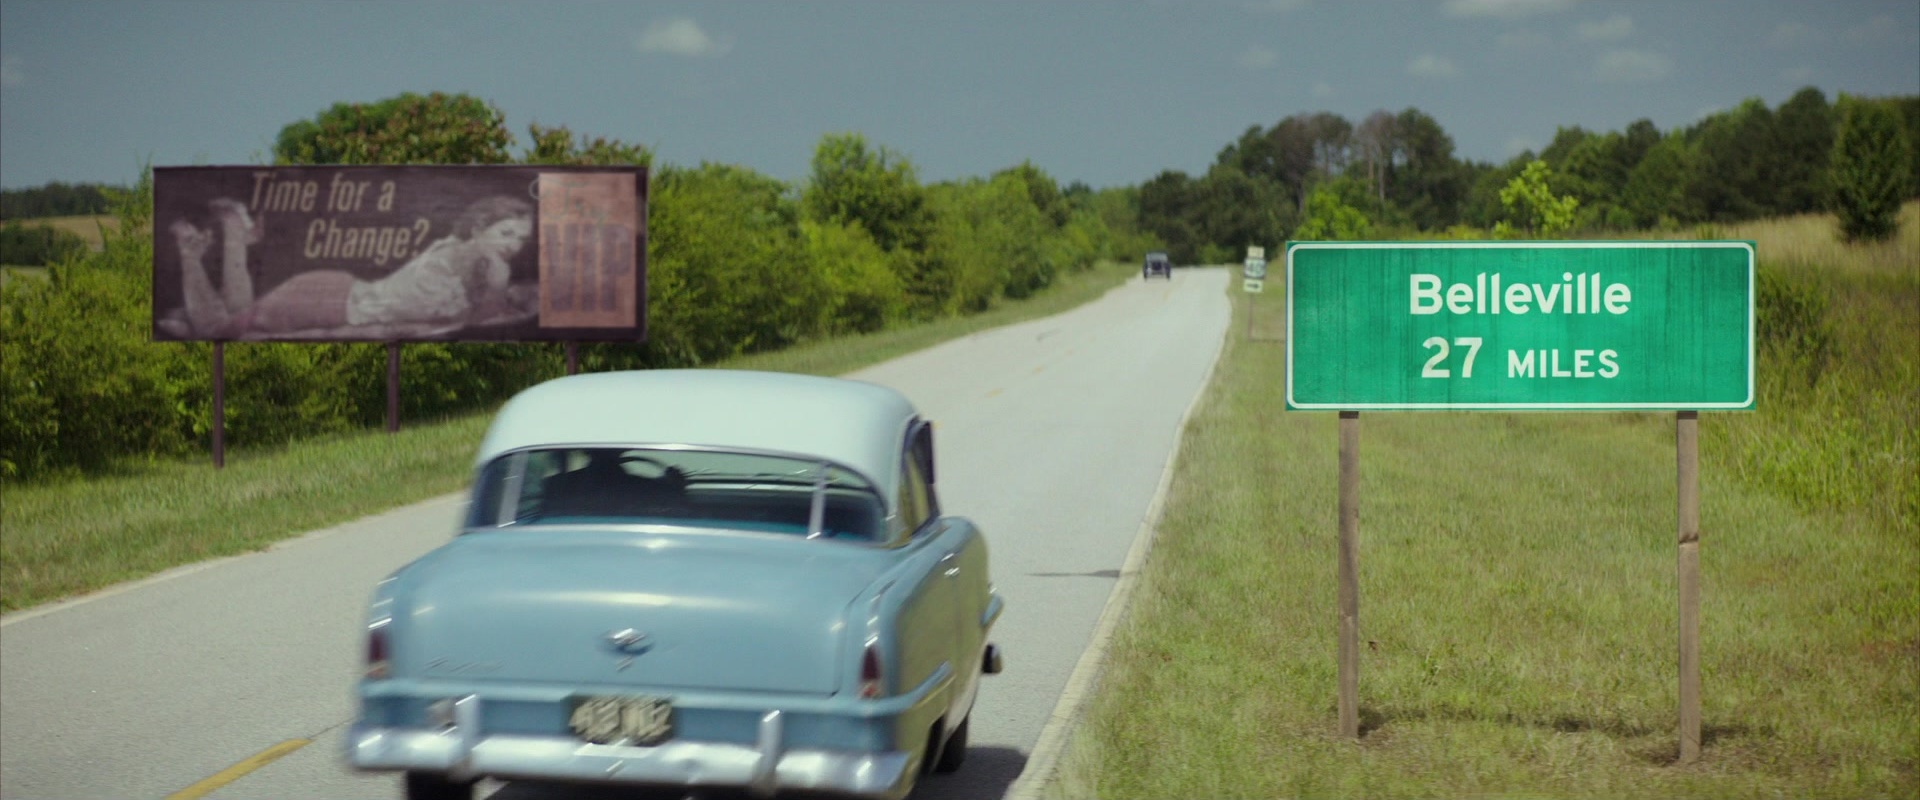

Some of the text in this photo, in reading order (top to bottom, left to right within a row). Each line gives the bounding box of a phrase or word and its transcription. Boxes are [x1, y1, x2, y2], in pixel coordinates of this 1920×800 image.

[251, 171, 396, 212] Time for a
[304, 218, 430, 266] Change?
[1409, 271, 1632, 315] Belleville
[1421, 336, 1620, 378] 27 MILES
